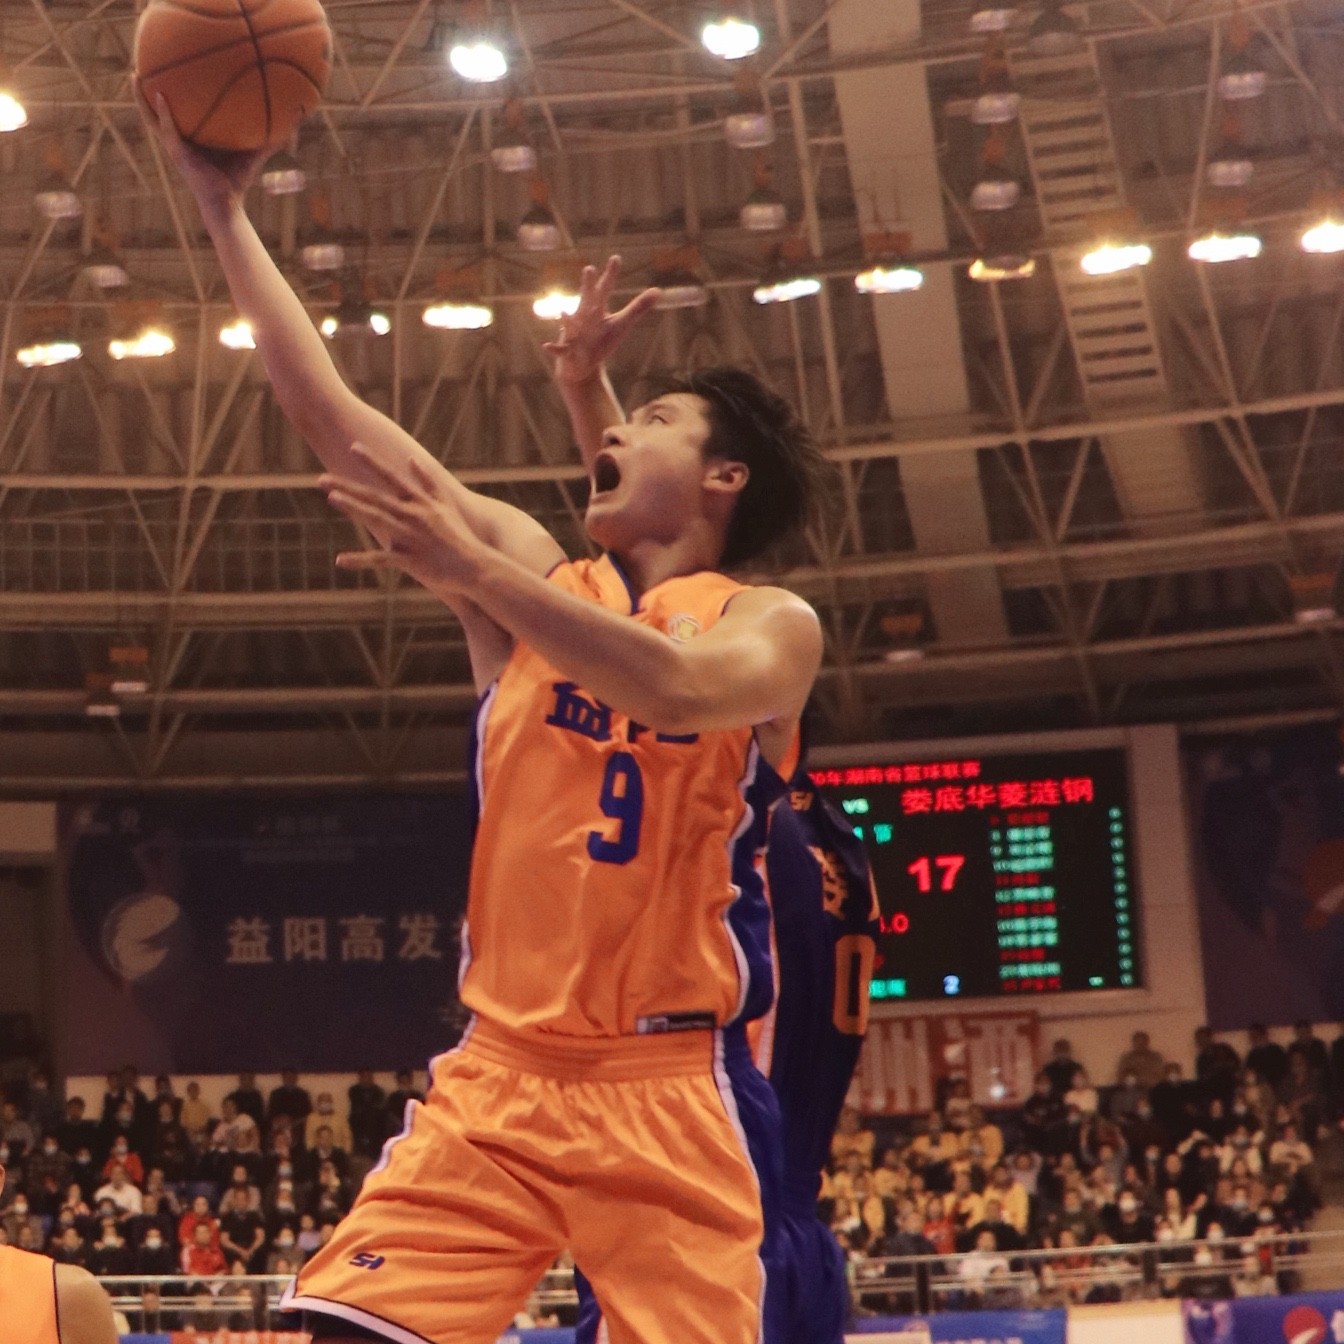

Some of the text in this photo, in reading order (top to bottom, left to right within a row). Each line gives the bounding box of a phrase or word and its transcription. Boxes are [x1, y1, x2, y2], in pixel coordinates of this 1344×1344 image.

[587, 751, 644, 865] 9
[901, 777, 1094, 815] 娄底华菱涟钢
[907, 855, 965, 893] 17
[224, 913, 444, 964] 益阳高发
[832, 933, 876, 1035] 0
